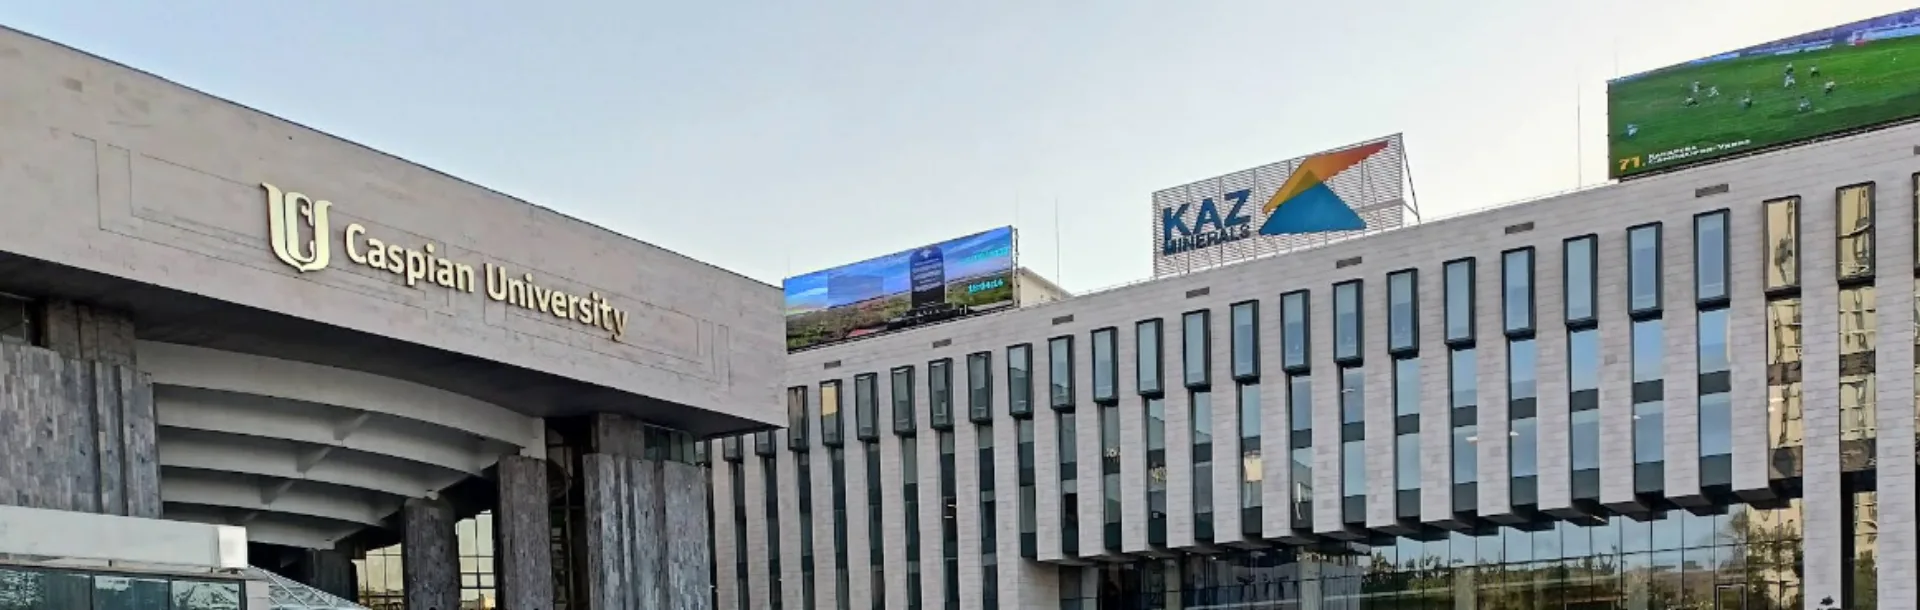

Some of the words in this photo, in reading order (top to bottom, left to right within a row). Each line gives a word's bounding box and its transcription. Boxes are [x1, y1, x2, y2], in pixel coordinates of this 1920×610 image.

[1163, 189, 1252, 241] KAZ
[1163, 225, 1250, 256] MINERALS
[345, 223, 475, 294] Caspian
[484, 263, 629, 342] University
